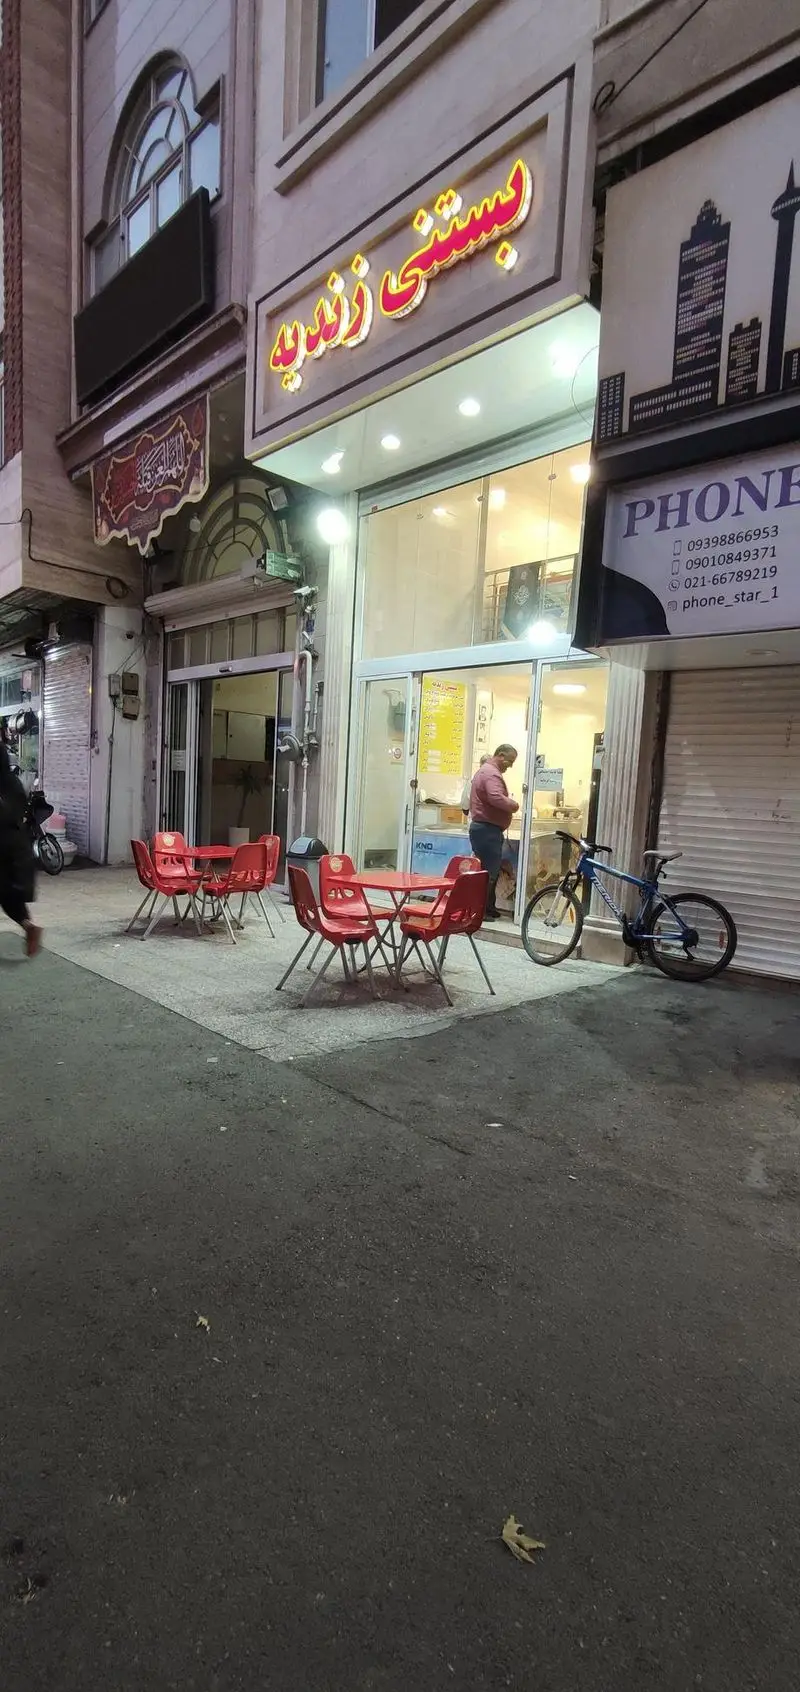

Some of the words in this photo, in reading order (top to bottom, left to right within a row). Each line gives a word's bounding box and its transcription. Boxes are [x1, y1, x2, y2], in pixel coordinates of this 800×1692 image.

[379, 158, 532, 320] بستنی
[269, 252, 374, 393] زندیه
[622, 463, 800, 538] PHONE
[687, 525, 779, 552] 09398866953
[685, 545, 777, 570] 09010849371
[683, 565, 778, 590] 021-66789219
[682, 586, 779, 612] phone_star_1
